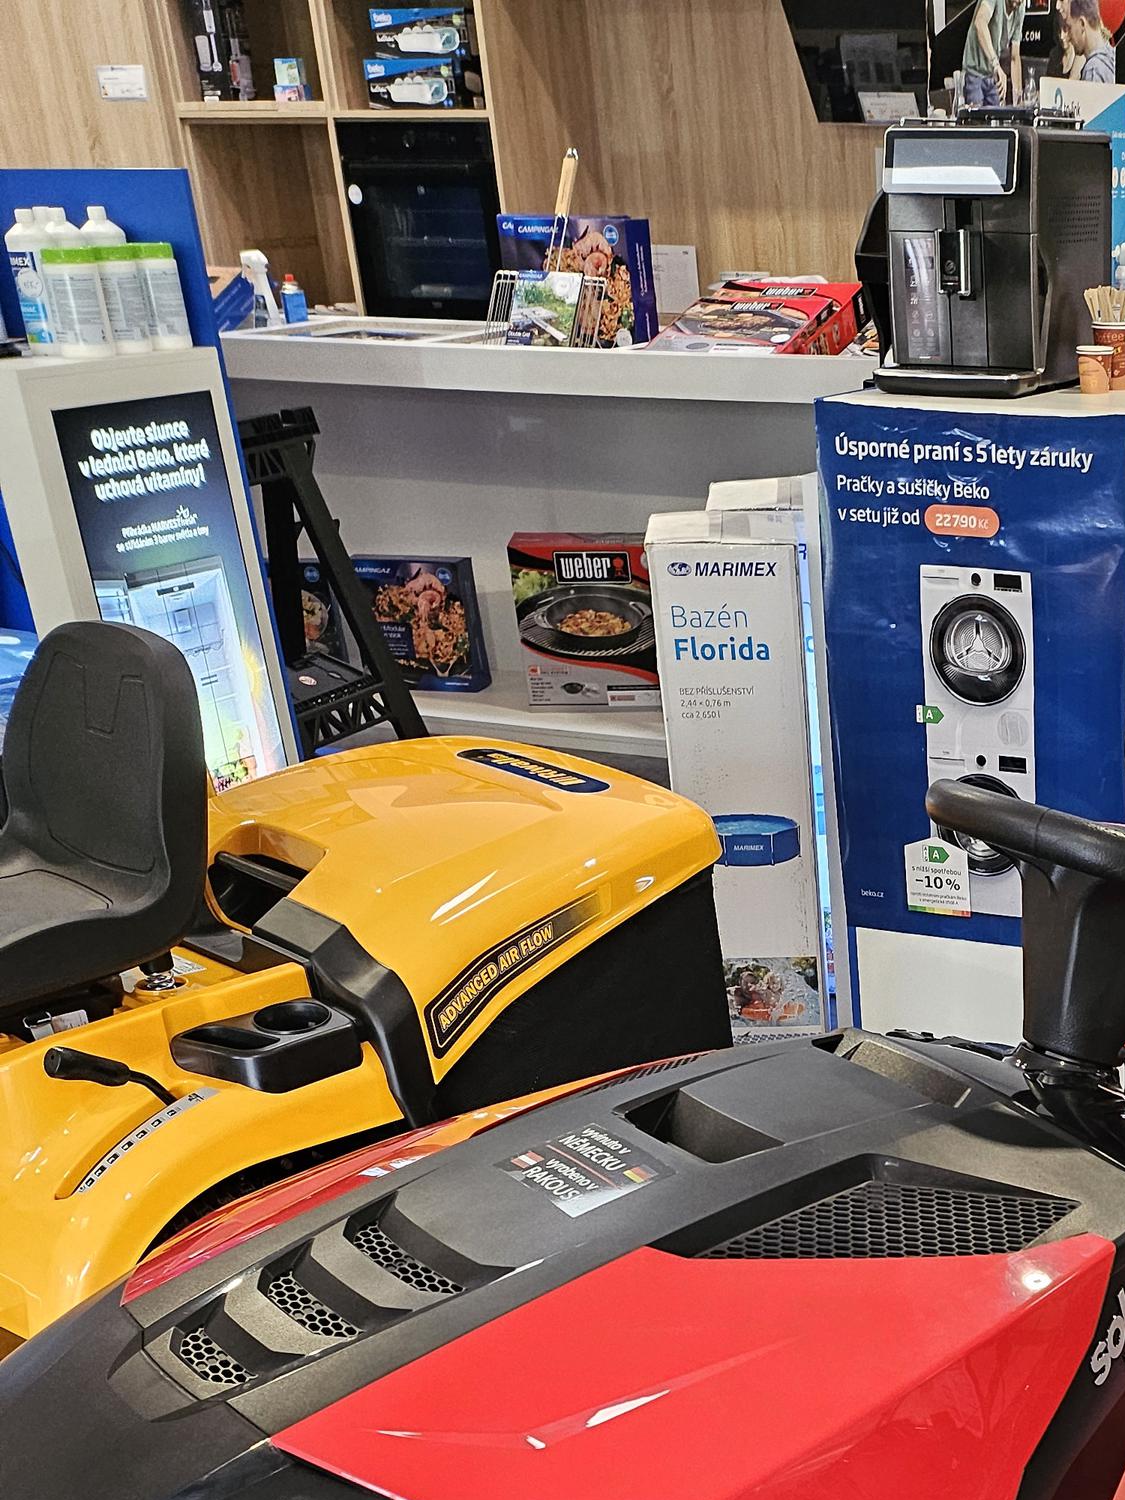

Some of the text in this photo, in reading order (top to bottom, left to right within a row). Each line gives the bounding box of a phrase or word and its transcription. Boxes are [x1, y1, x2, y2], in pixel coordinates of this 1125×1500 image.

[90, 420, 190, 453] Objevte slunce
[835, 432, 1094, 474] Úsporné praní s 5 lety záruky
[94, 473, 147, 503] uchová
[836, 475, 990, 501] Pračky a sušičky Beko
[837, 506, 920, 527] v setu již od
[978, 518, 990, 530] Kč
[559, 557, 612, 580] weber
[694, 562, 778, 577] MARIMEX
[671, 603, 749, 629] Bazén
[674, 636, 771, 661] Florida
[679, 685, 755, 696] BEZ PŘÍSLUŠENSTVÍ
[681, 699, 697, 708] 2,44
[705, 699, 722, 708] 0,76
[926, 709, 934, 720] A
[932, 850, 940, 860] A
[945, 878, 961, 891] %
[437, 921, 554, 1032] ADVANCED AIR FLOW
[582, 1127, 623, 1150] vyvinuto
[559, 1134, 627, 1172] NĚMECKU
[522, 1165, 584, 1202] RAKOUS
[545, 1158, 592, 1188] vyrobeno
